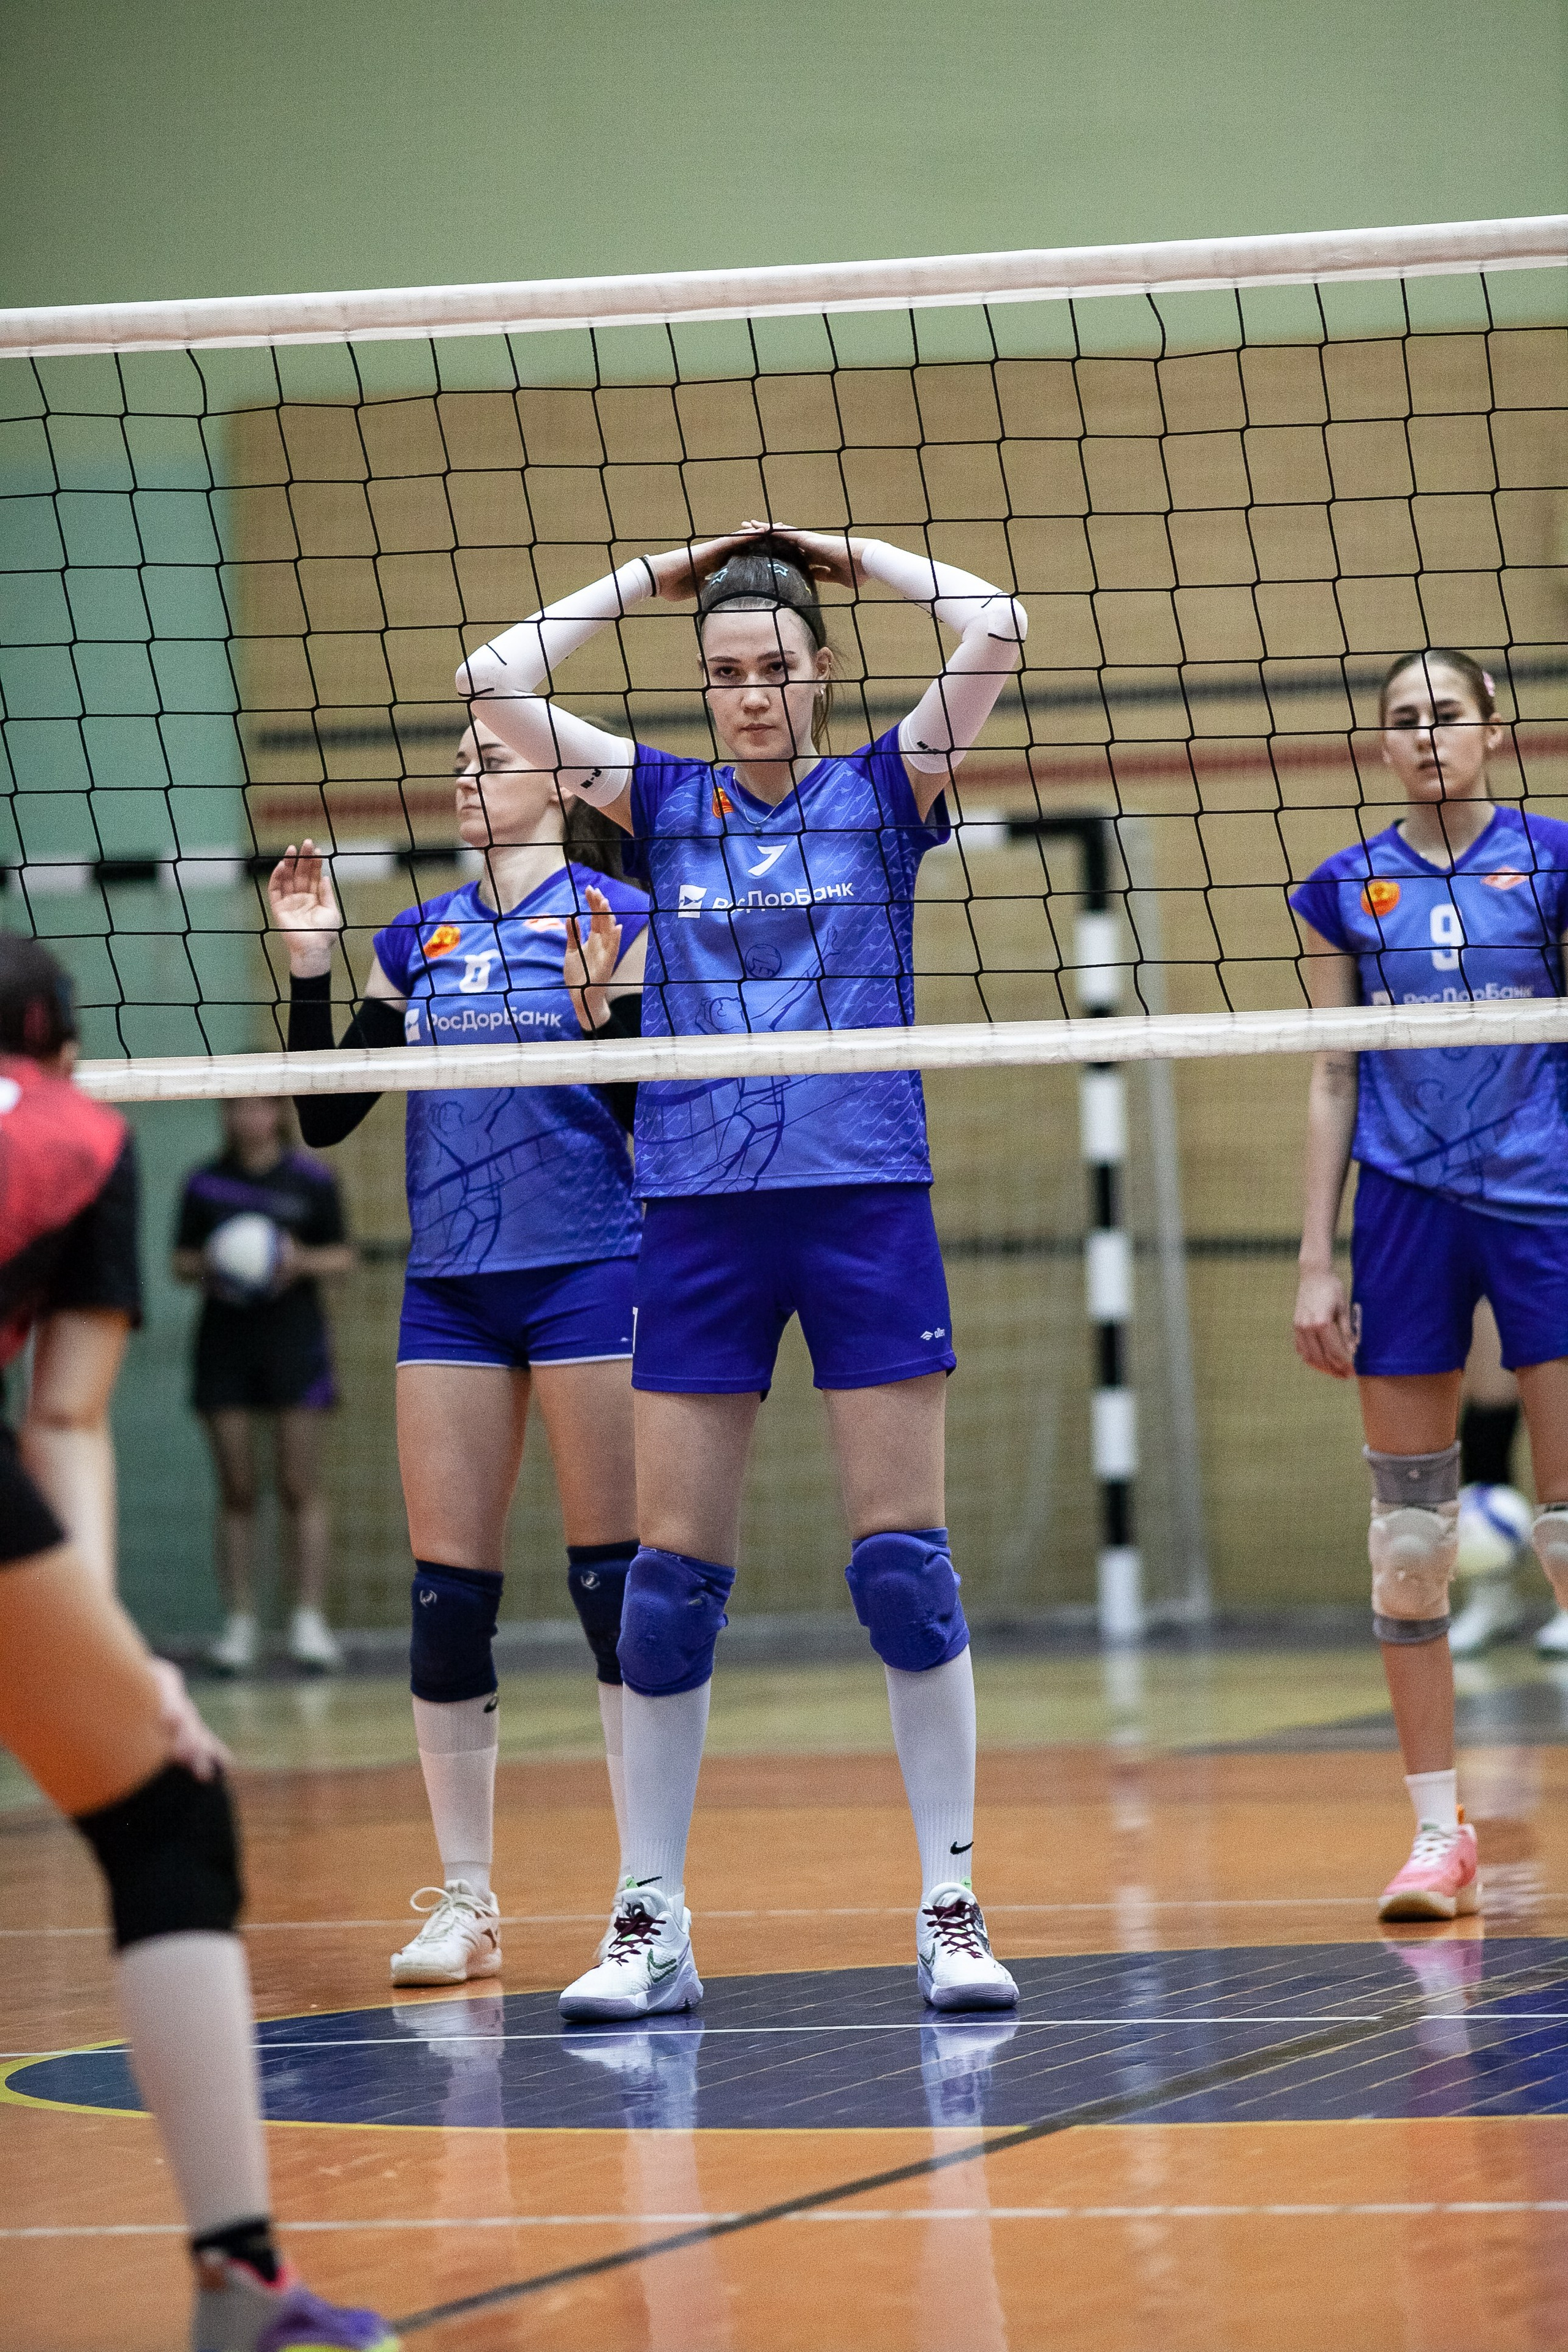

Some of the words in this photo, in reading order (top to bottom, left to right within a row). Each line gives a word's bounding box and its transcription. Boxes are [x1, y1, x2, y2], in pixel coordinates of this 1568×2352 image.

[748, 845, 787, 876] 7
[1430, 903, 1463, 971] 9
[426, 1006, 563, 1031] РосДорБанк
